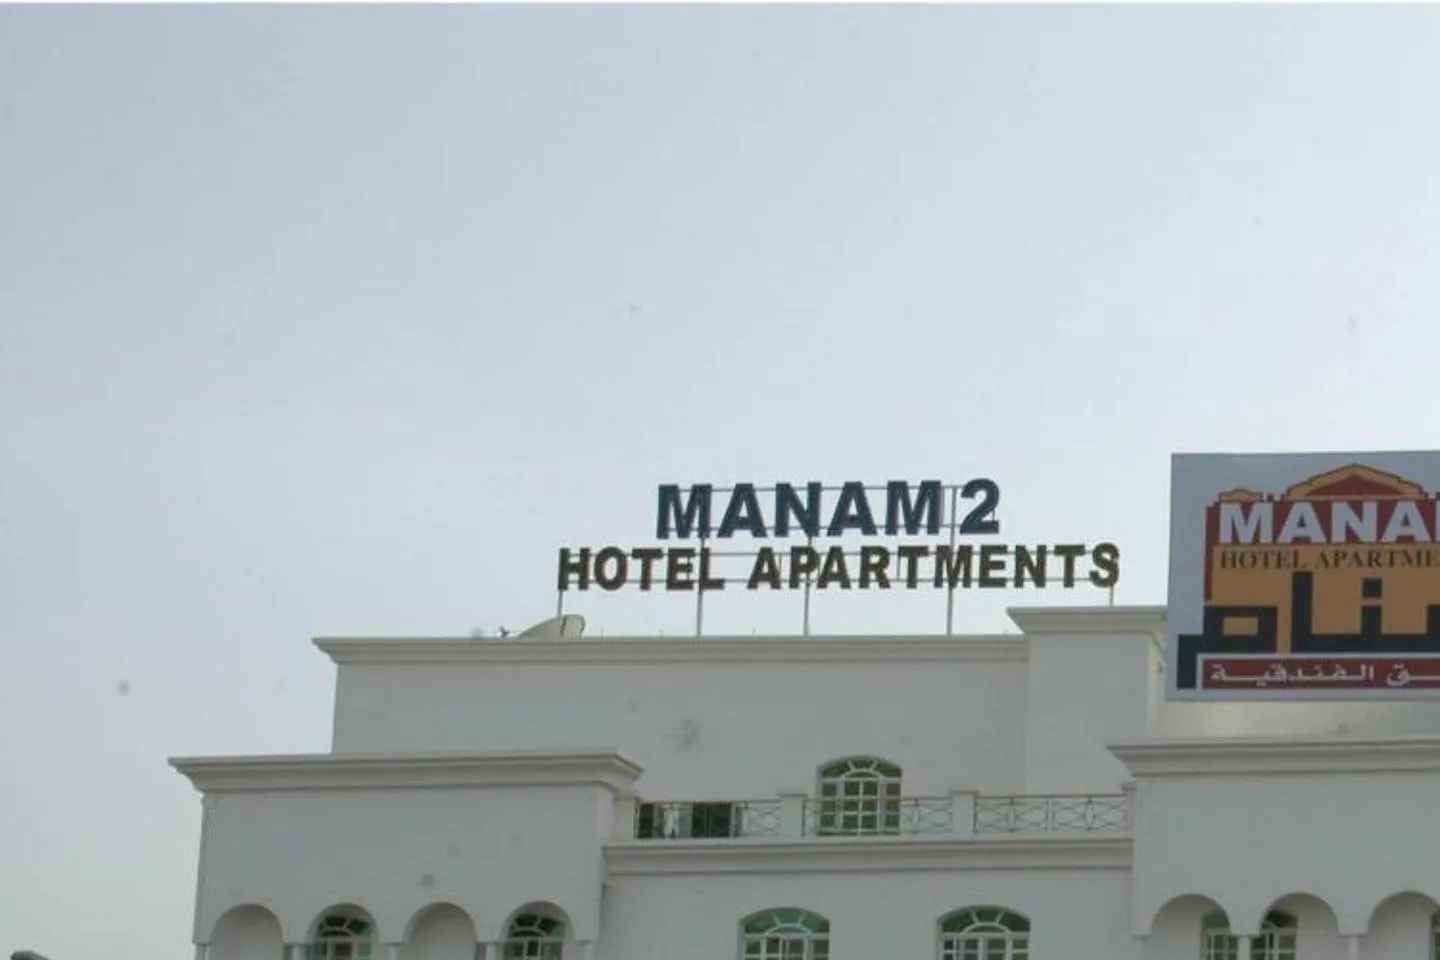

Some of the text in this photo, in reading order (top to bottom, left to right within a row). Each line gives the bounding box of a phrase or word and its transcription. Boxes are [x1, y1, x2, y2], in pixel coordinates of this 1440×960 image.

[557, 543, 1120, 592] HOTEL APARTMENTS
[1220, 548, 1307, 570] HOTEL
